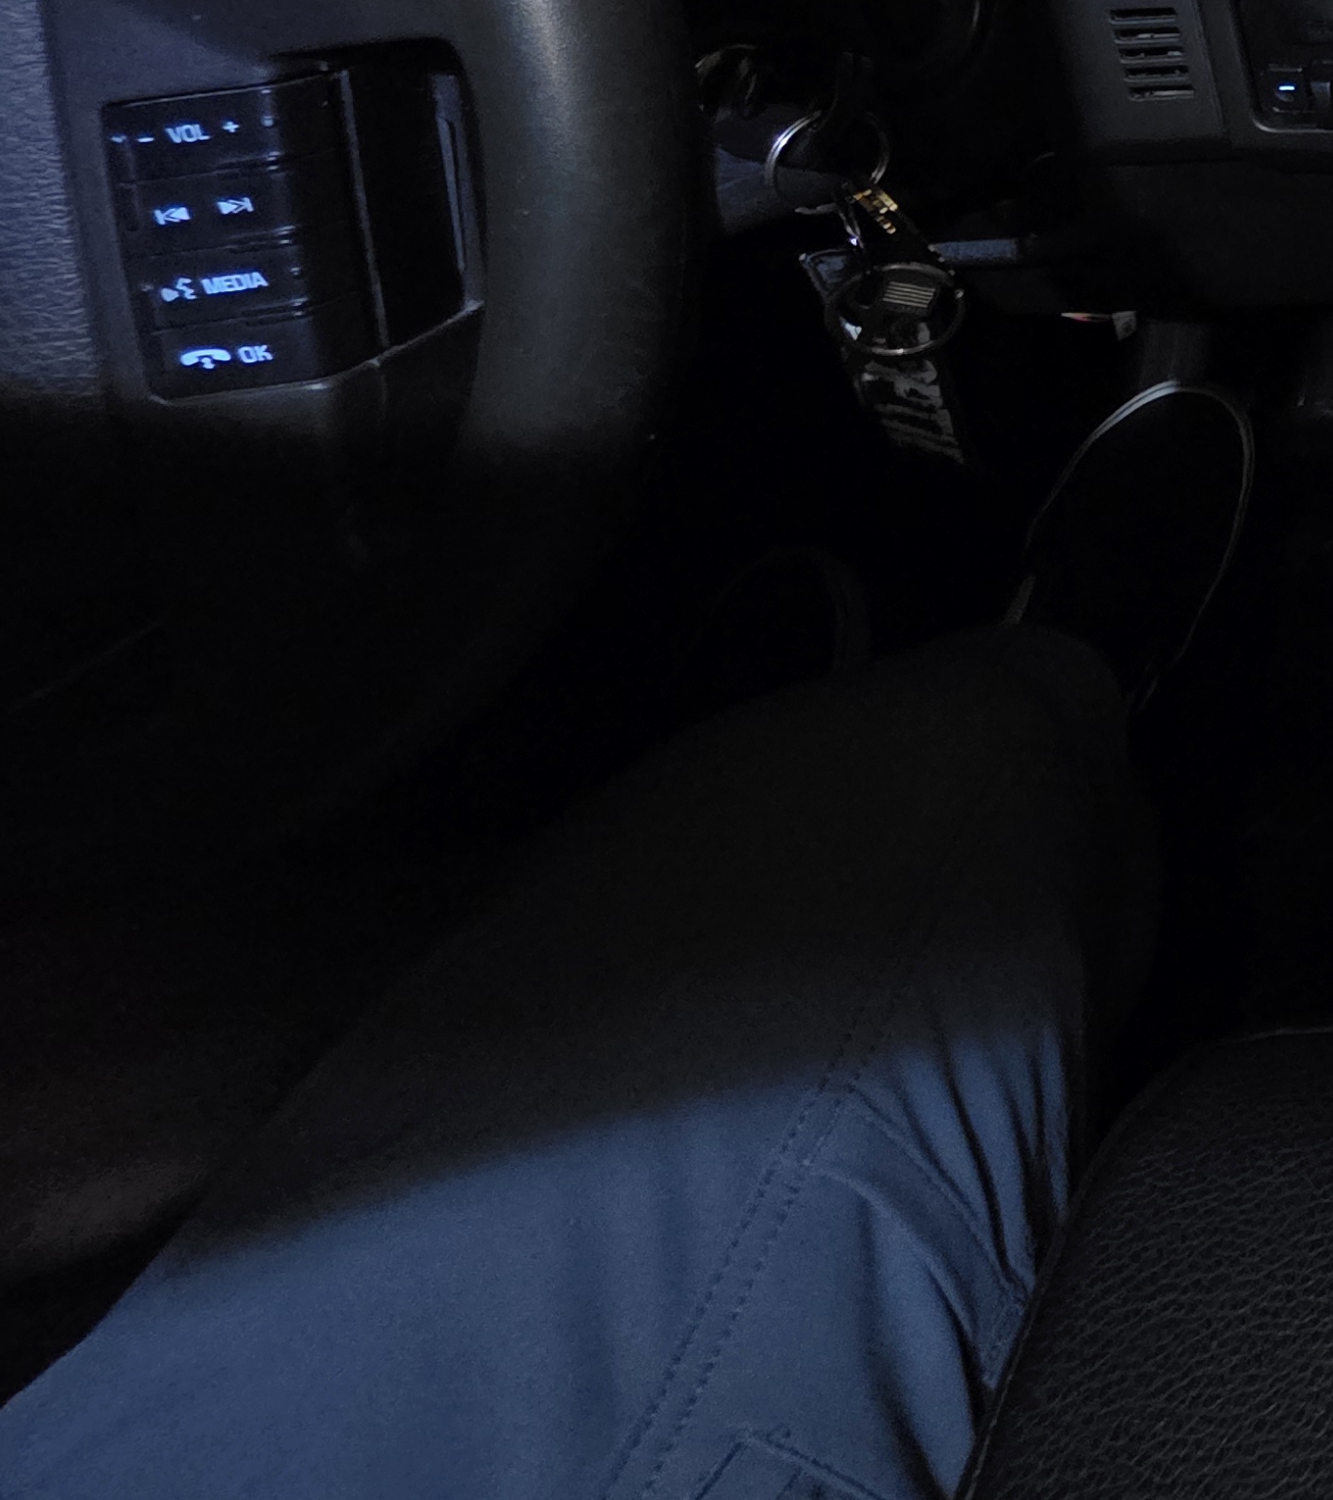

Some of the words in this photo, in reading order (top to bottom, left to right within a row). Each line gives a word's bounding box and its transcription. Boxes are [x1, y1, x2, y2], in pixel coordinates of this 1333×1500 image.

[165, 122, 211, 144] VOL
[200, 271, 269, 295] MEDIA
[236, 344, 273, 364] OK
